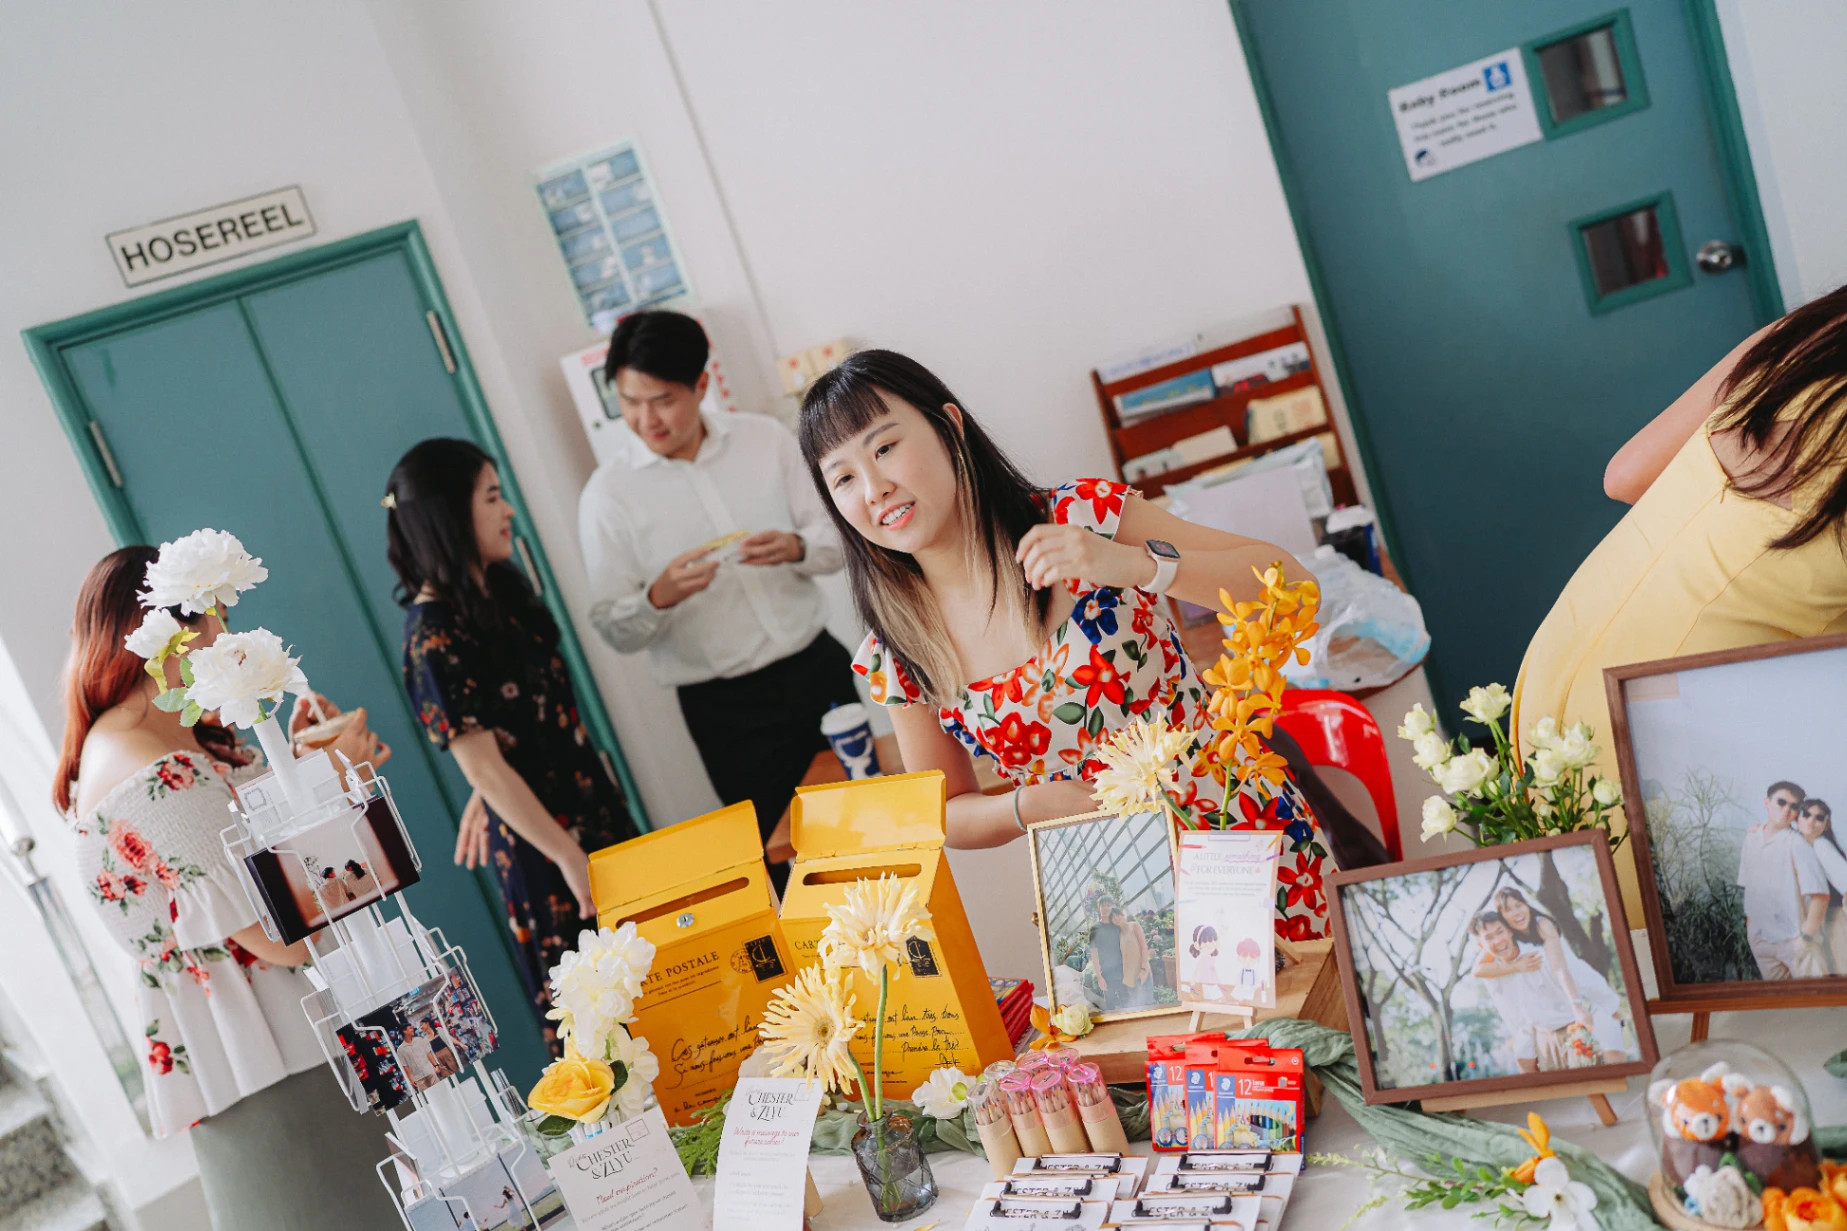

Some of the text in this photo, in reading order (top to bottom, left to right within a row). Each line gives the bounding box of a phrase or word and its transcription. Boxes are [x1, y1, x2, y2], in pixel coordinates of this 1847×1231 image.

[120, 203, 305, 271] HOSEREEL
[665, 951, 720, 977] POSTALE
[1170, 1066, 1184, 1081] 12
[1238, 1078, 1252, 1095] 12
[748, 1092, 794, 1106] CHESTER
[576, 1138, 636, 1172] CHESTER
